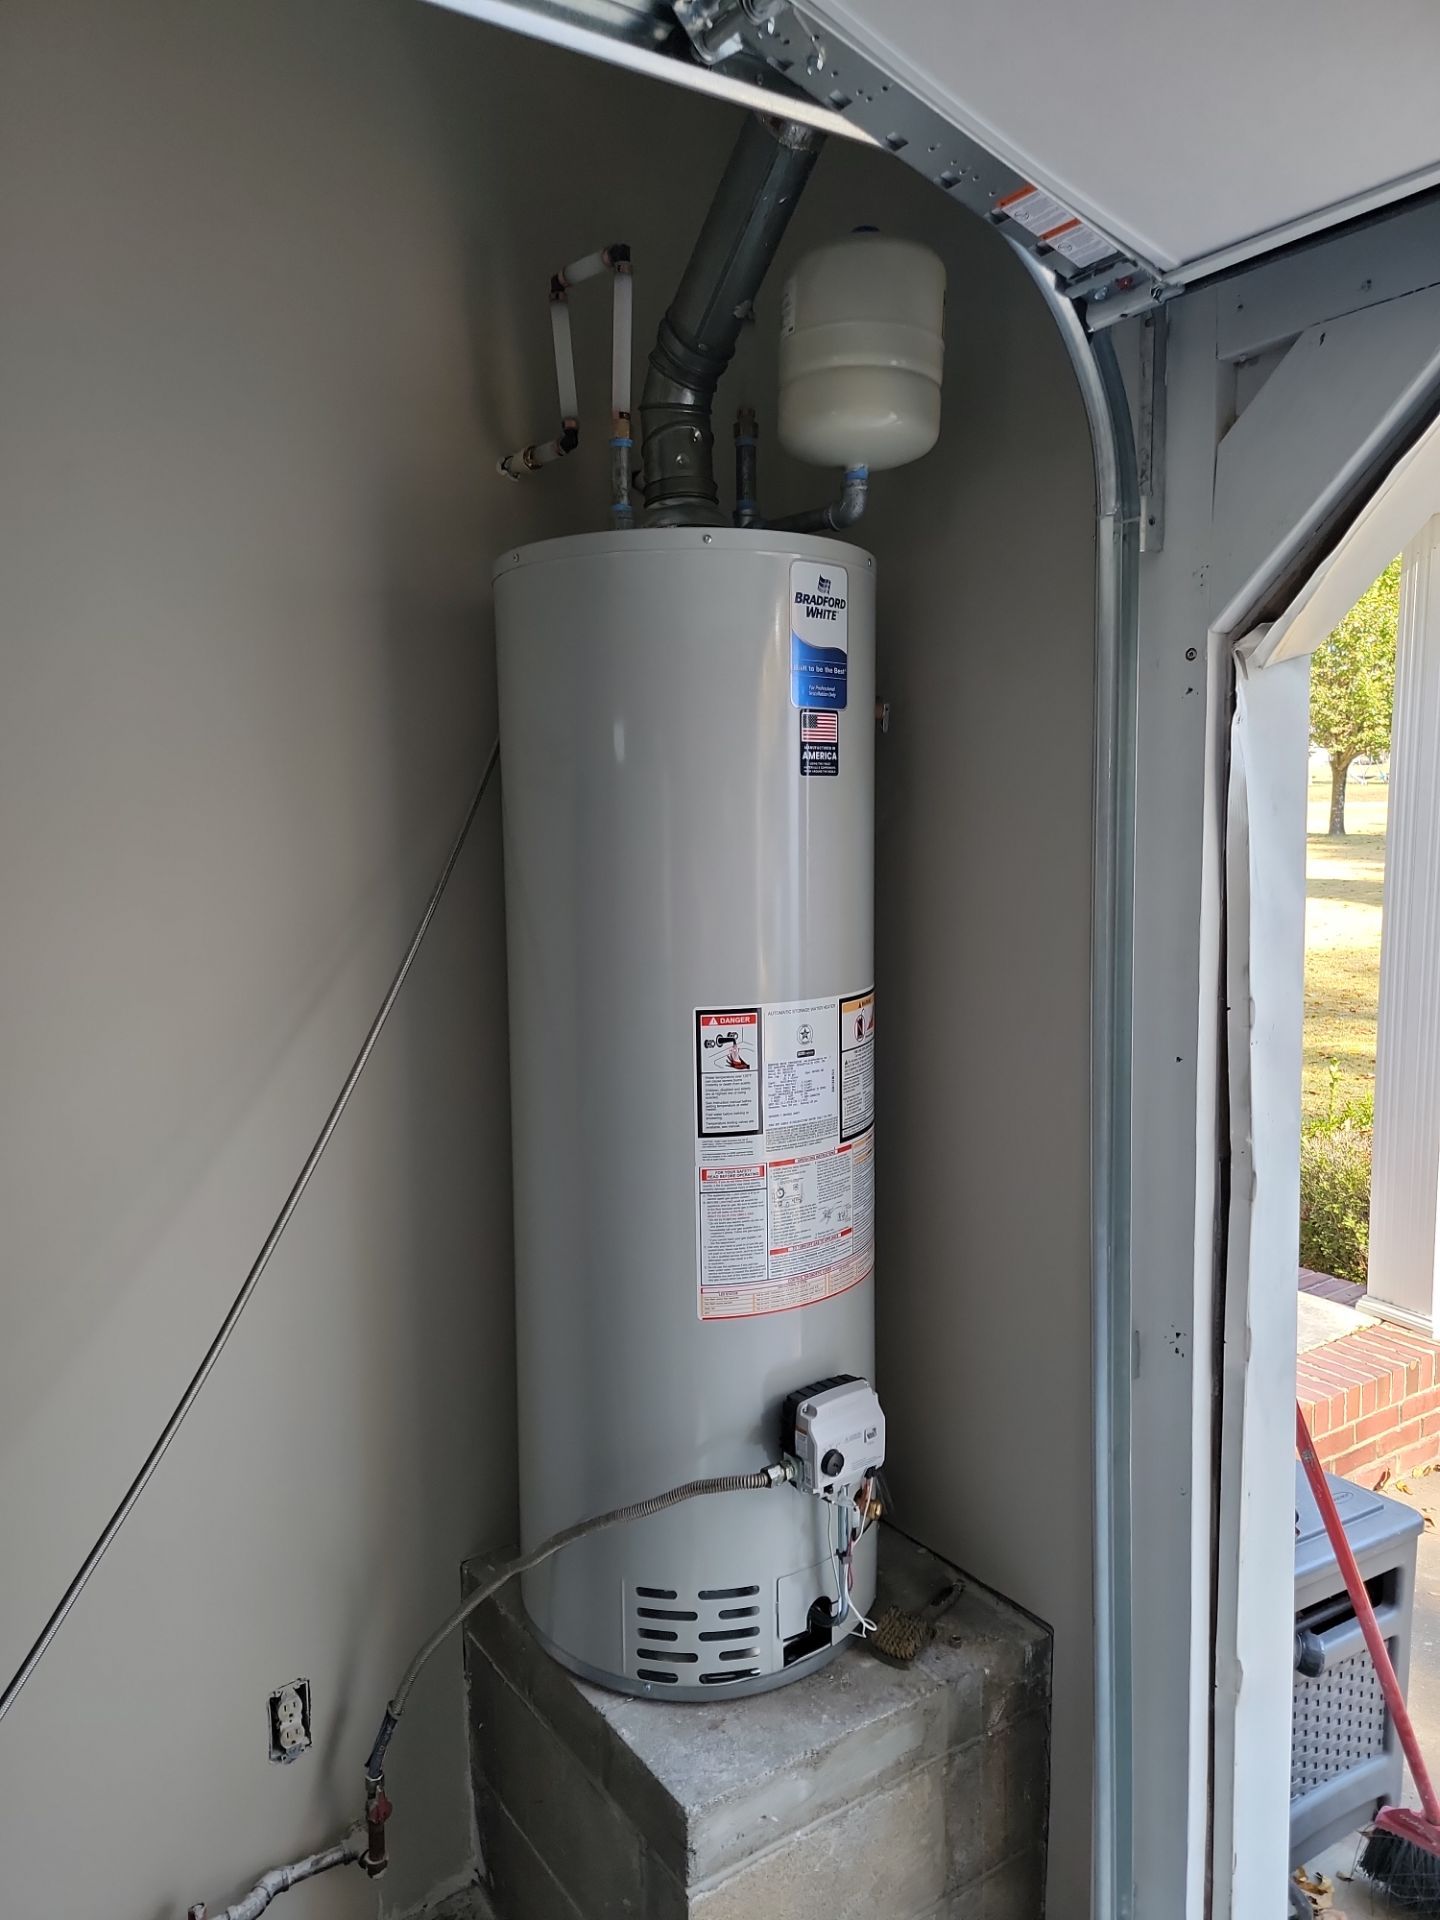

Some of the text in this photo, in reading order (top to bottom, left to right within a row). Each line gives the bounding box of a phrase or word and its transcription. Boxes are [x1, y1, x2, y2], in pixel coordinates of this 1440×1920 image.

[795, 592, 846, 610] BRADFORD
[805, 606, 837, 620] WHITE
[802, 751, 837, 760] AMERICA
